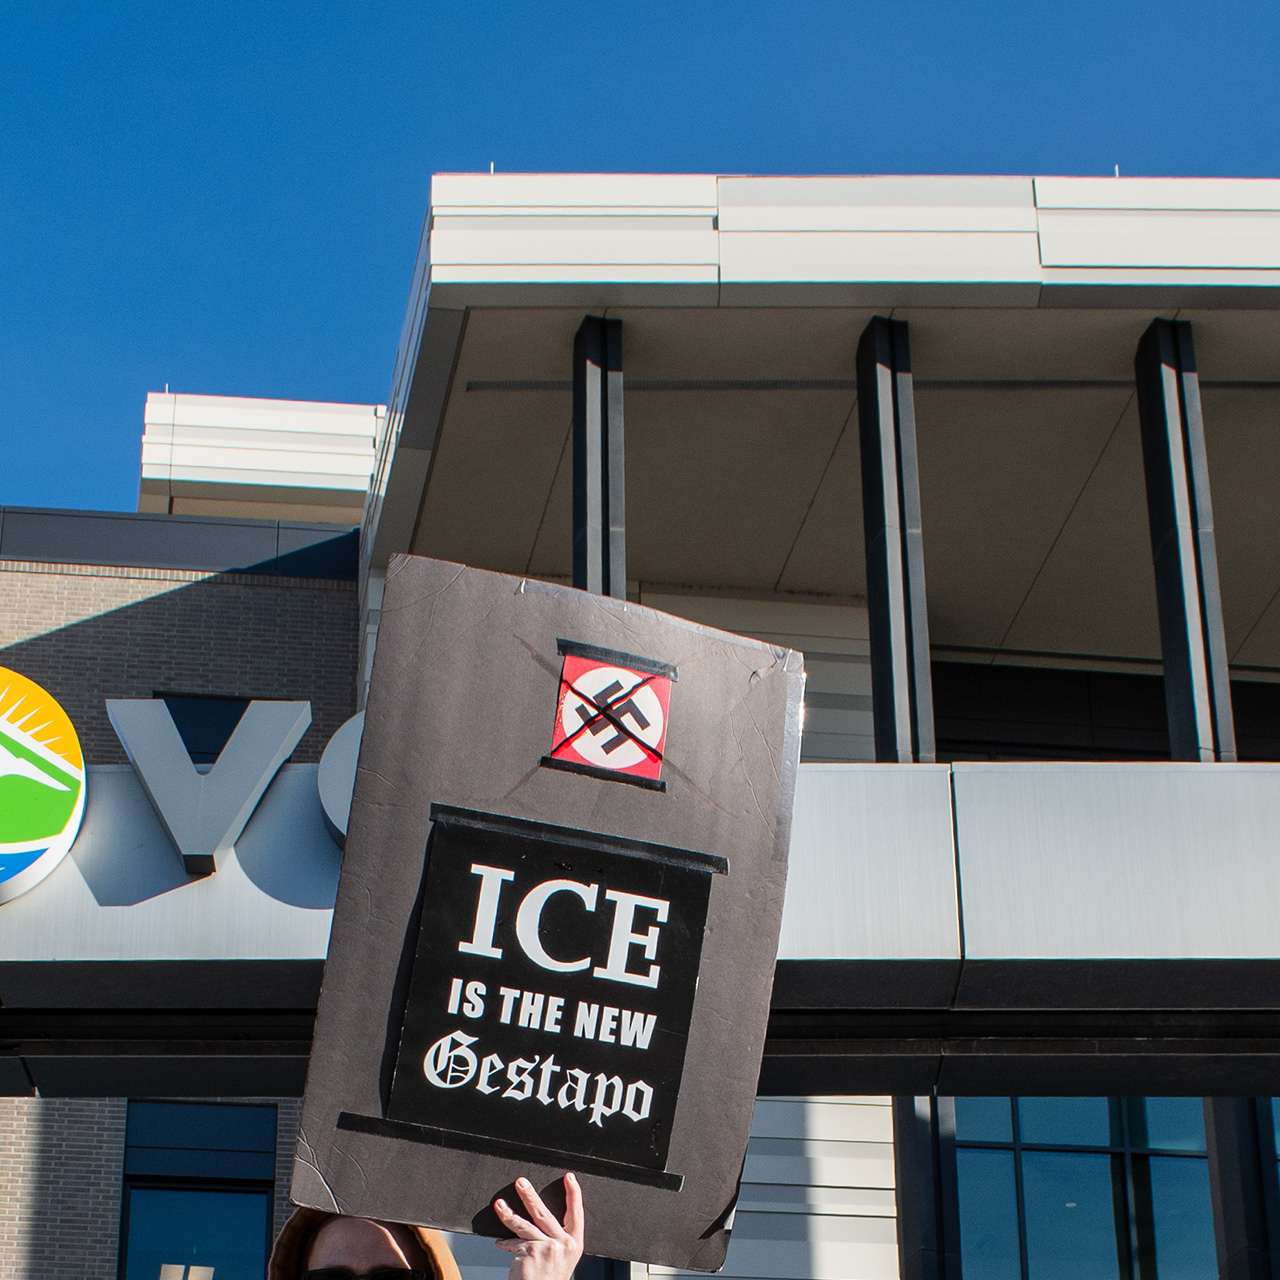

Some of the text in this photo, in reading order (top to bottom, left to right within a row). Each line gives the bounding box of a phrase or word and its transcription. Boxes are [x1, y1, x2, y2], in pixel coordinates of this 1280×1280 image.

[457, 863, 671, 989] ICE
[447, 977, 658, 1050] IS THE NEW
[423, 1029, 654, 1128] Gestapo
